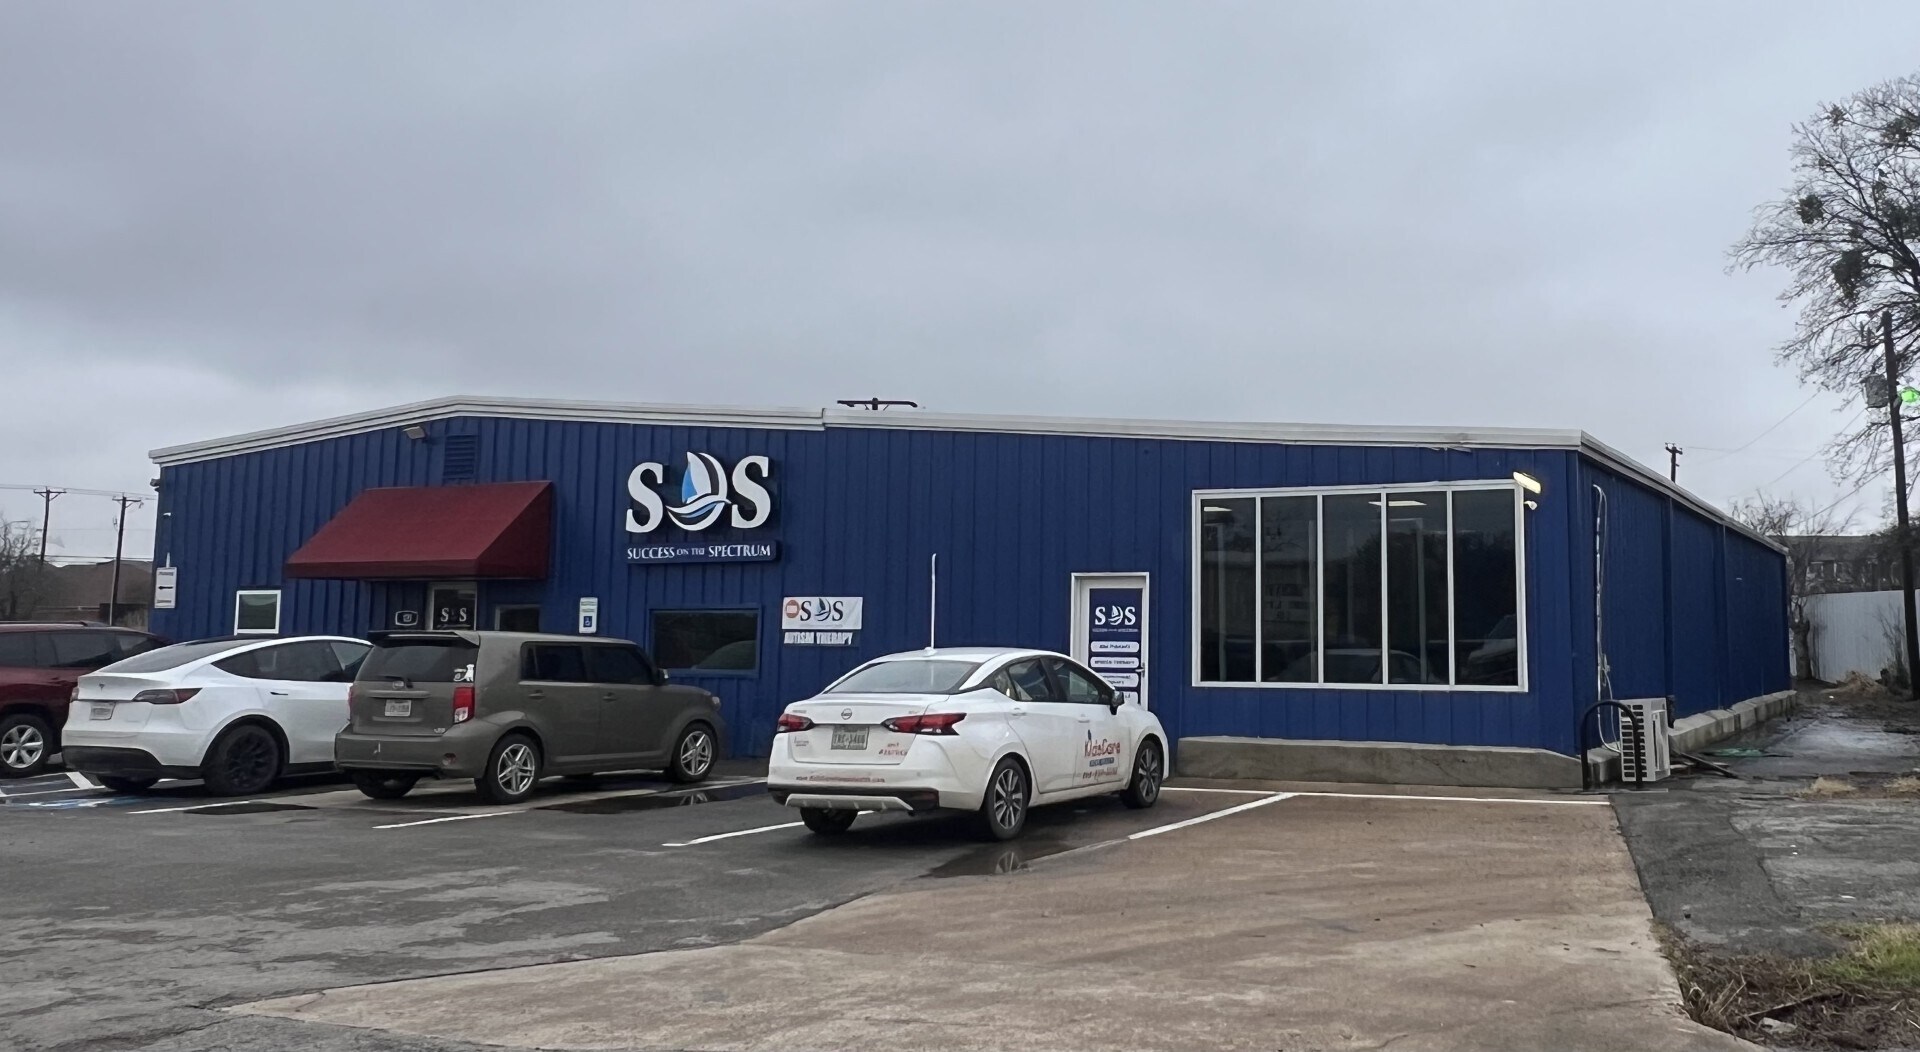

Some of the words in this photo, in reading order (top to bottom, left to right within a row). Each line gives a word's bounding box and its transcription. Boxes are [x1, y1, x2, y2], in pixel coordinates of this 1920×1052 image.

[625, 452, 771, 533] SOS
[627, 547, 675, 560] SUCCESS
[708, 544, 771, 558] SPECTRUM
[800, 597, 844, 622] SOS
[1094, 605, 1136, 626] SOS
[816, 631, 853, 646] THERAPY
